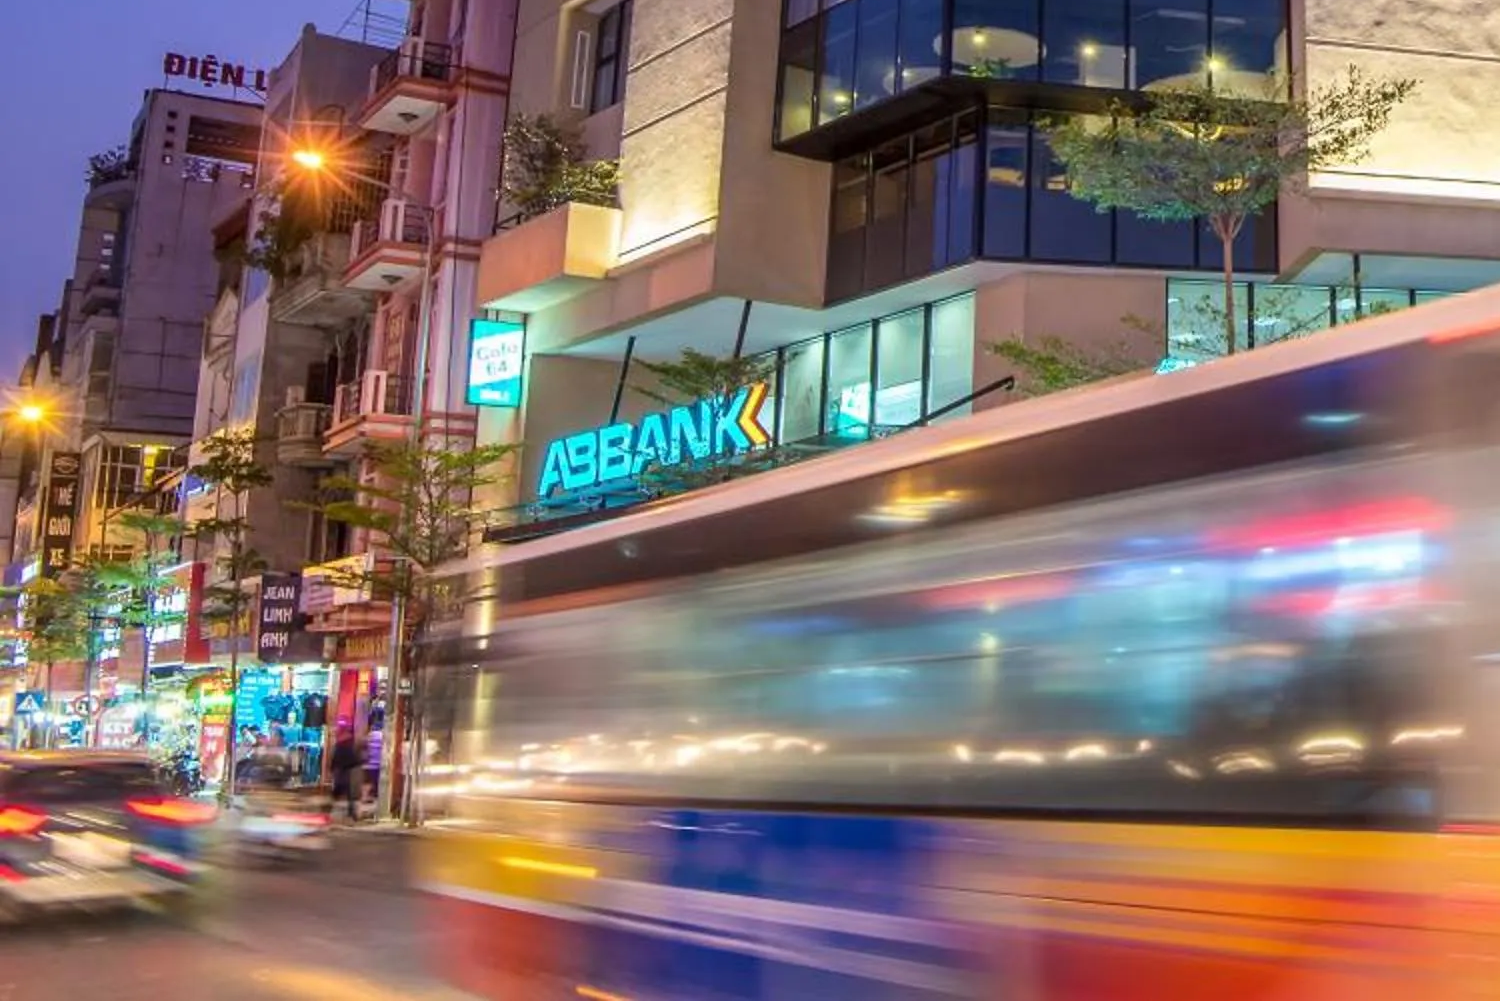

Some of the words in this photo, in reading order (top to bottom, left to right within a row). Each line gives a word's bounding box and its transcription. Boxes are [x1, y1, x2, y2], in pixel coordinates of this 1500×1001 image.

[163, 52, 245, 88] ĐIỆN
[538, 385, 752, 497] ABBANK
[263, 585, 295, 600] JEAN
